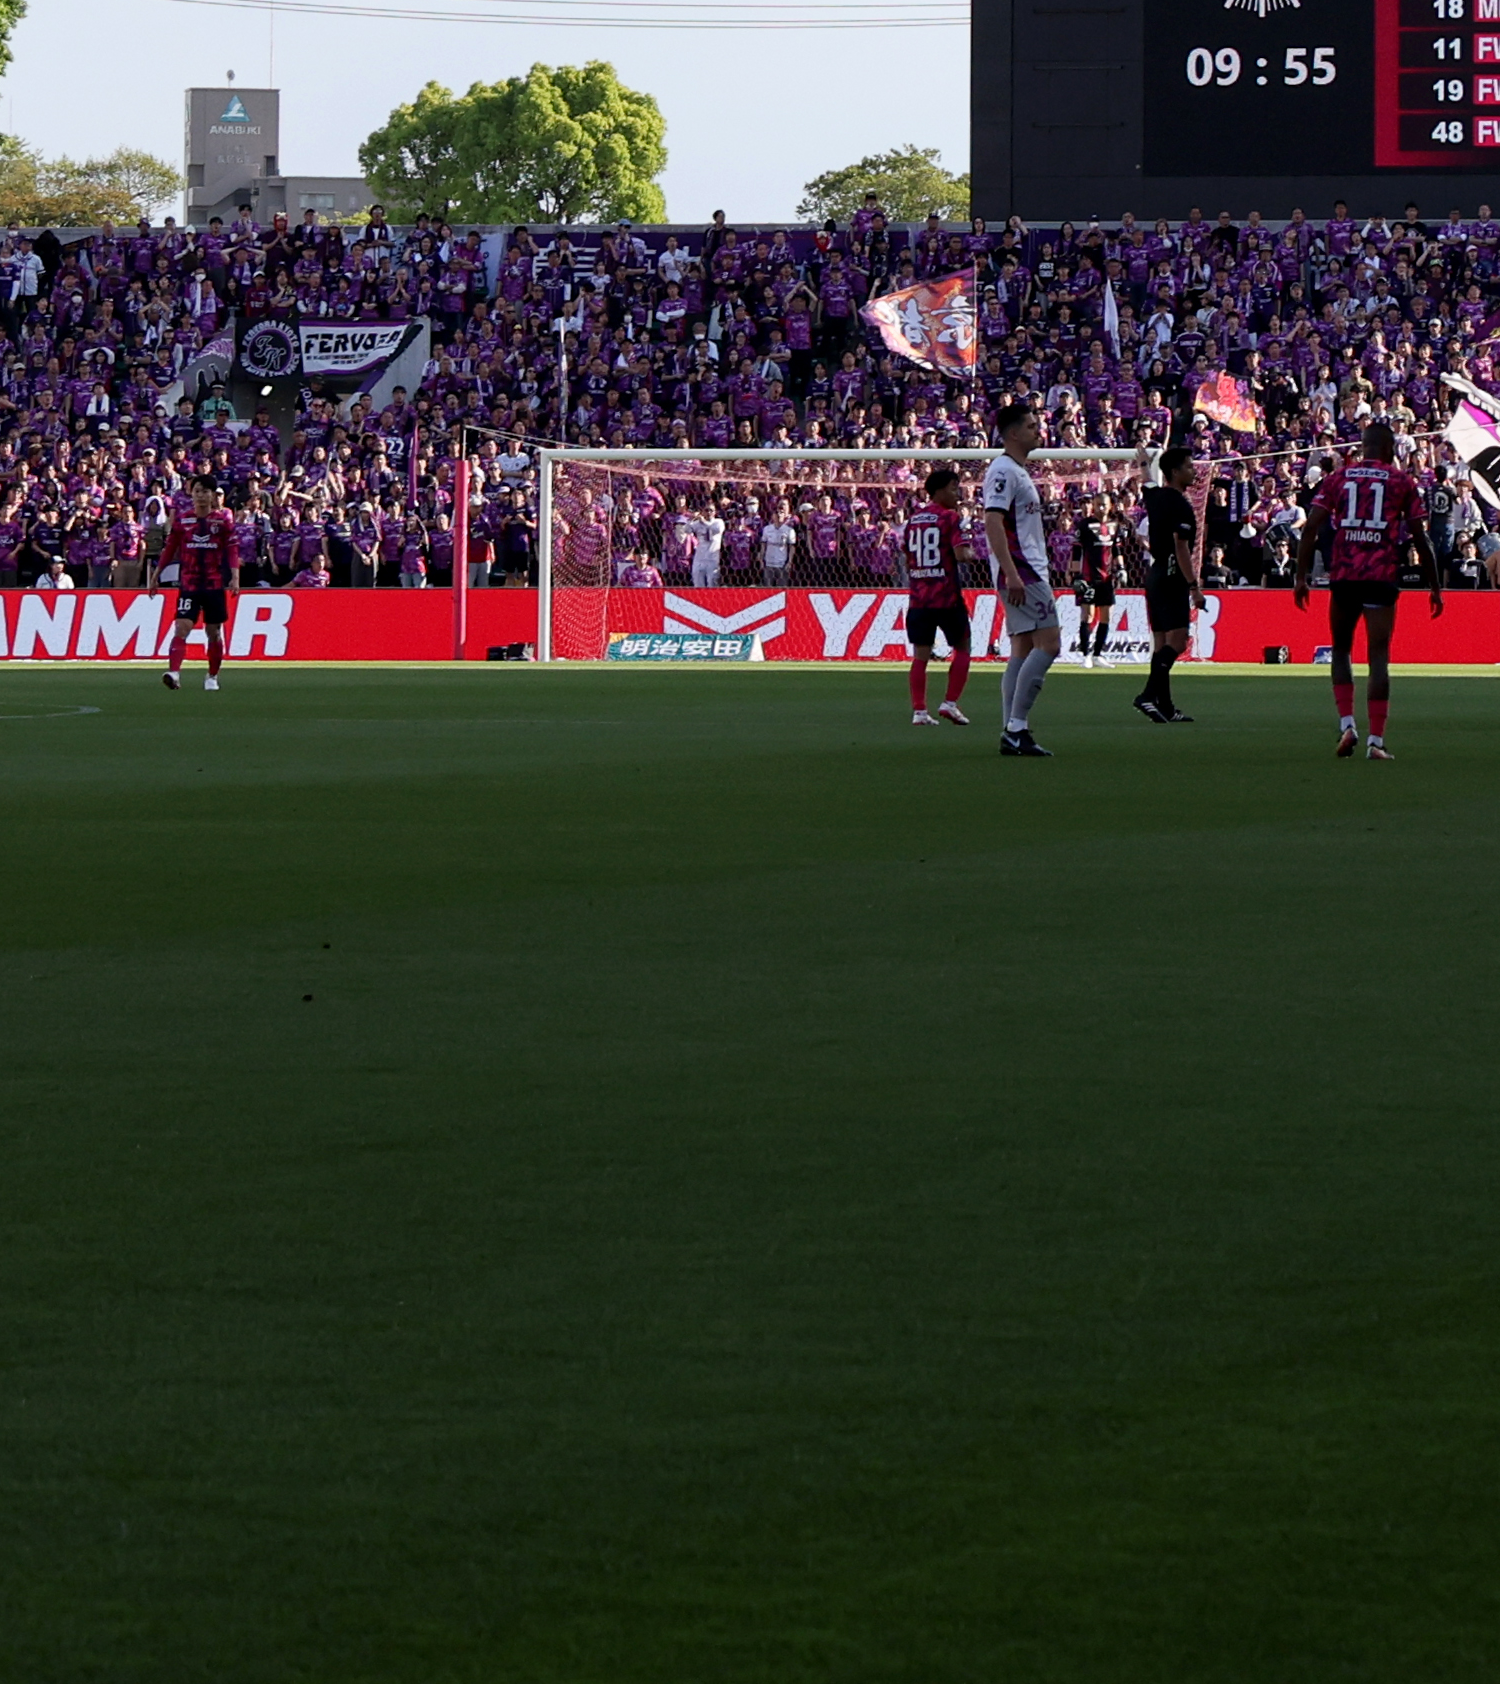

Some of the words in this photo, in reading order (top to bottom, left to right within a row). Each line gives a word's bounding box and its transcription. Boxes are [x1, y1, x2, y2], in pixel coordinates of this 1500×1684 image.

[1433, 37, 1461, 60] 11
[1432, 79, 1464, 102] 19
[209, 125, 261, 135] ANABUKI
[1431, 121, 1464, 143] 48
[1340, 480, 1388, 529] 11
[1345, 529, 1381, 543] THIAGO
[908, 527, 940, 568] 48
[620, 638, 743, 657] 明治安田
